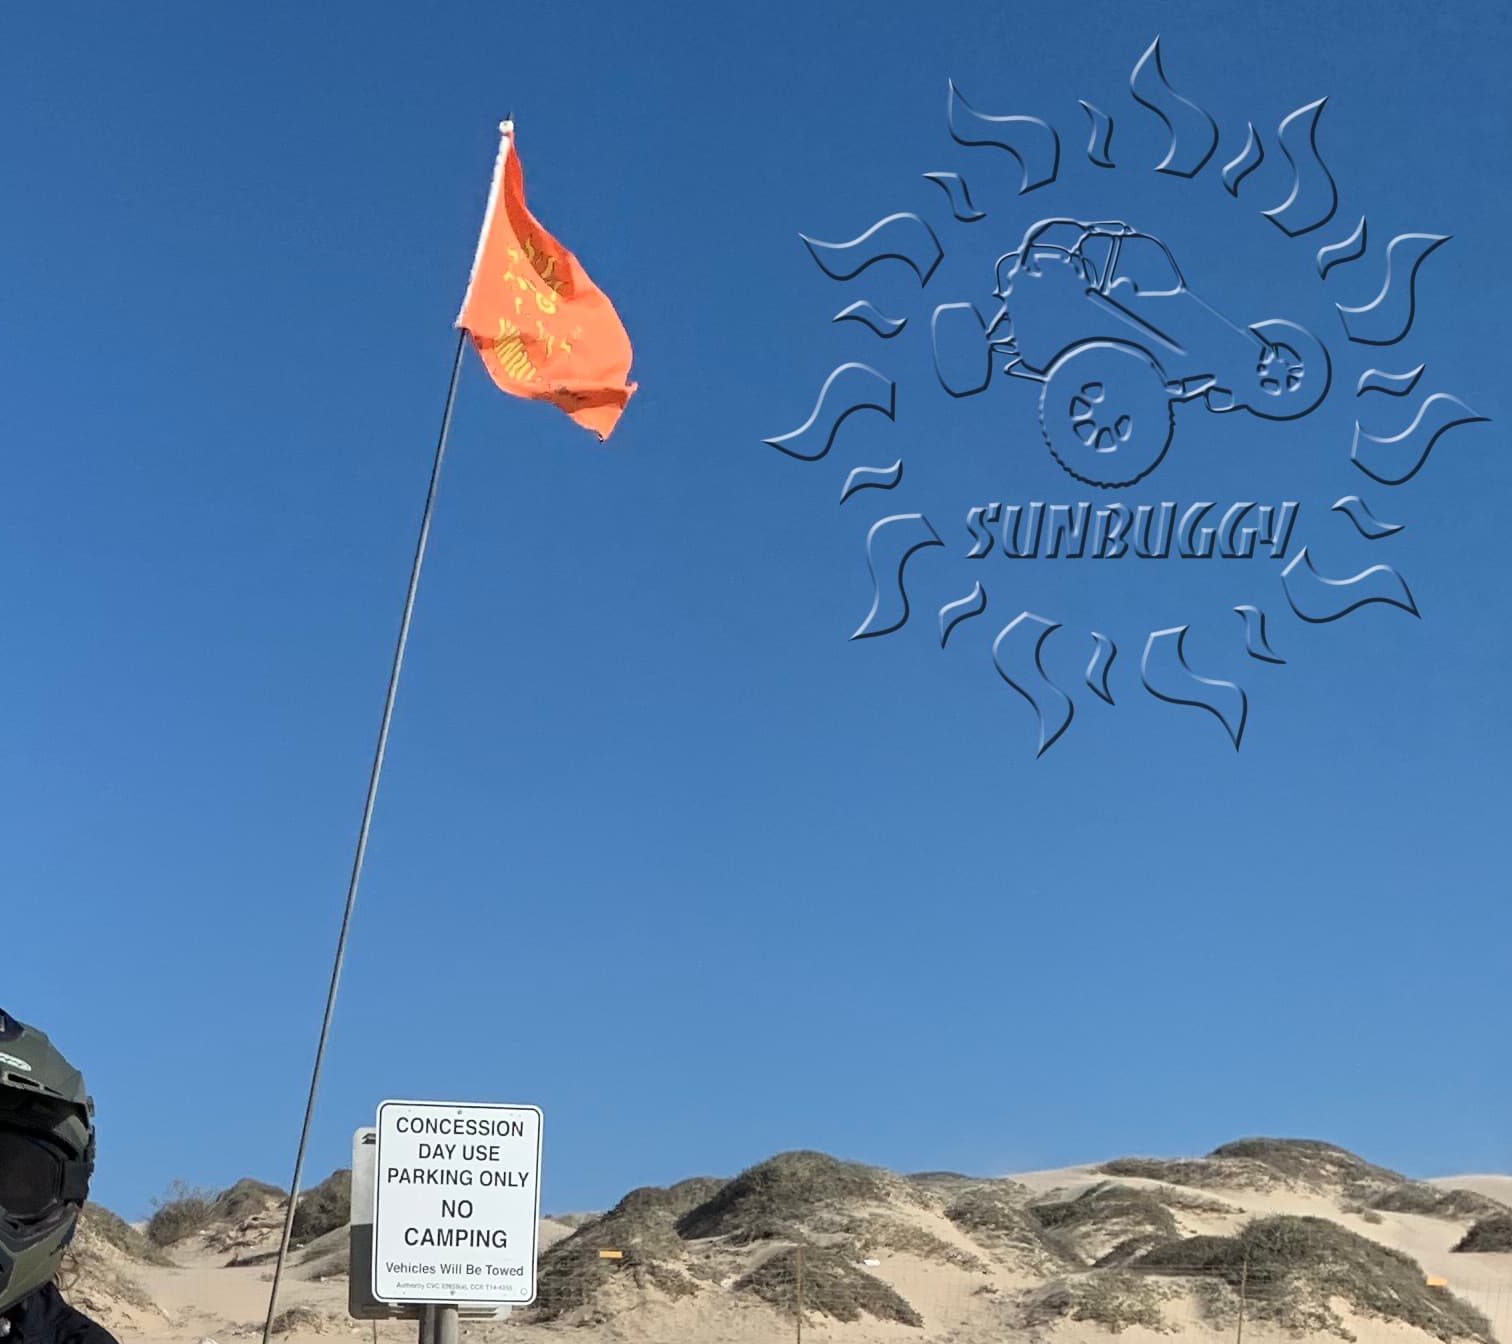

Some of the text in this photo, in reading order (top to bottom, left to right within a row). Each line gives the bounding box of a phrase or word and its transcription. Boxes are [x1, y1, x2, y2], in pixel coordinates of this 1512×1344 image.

[396, 1117, 524, 1137] CONCESSION
[418, 1143, 500, 1161] DAY USE
[387, 1168, 529, 1187] PARKING ONLY
[441, 1199, 473, 1218] NO
[404, 1228, 507, 1248] CAMPING
[386, 1262, 524, 1276] Vehicles Will Be Towed
